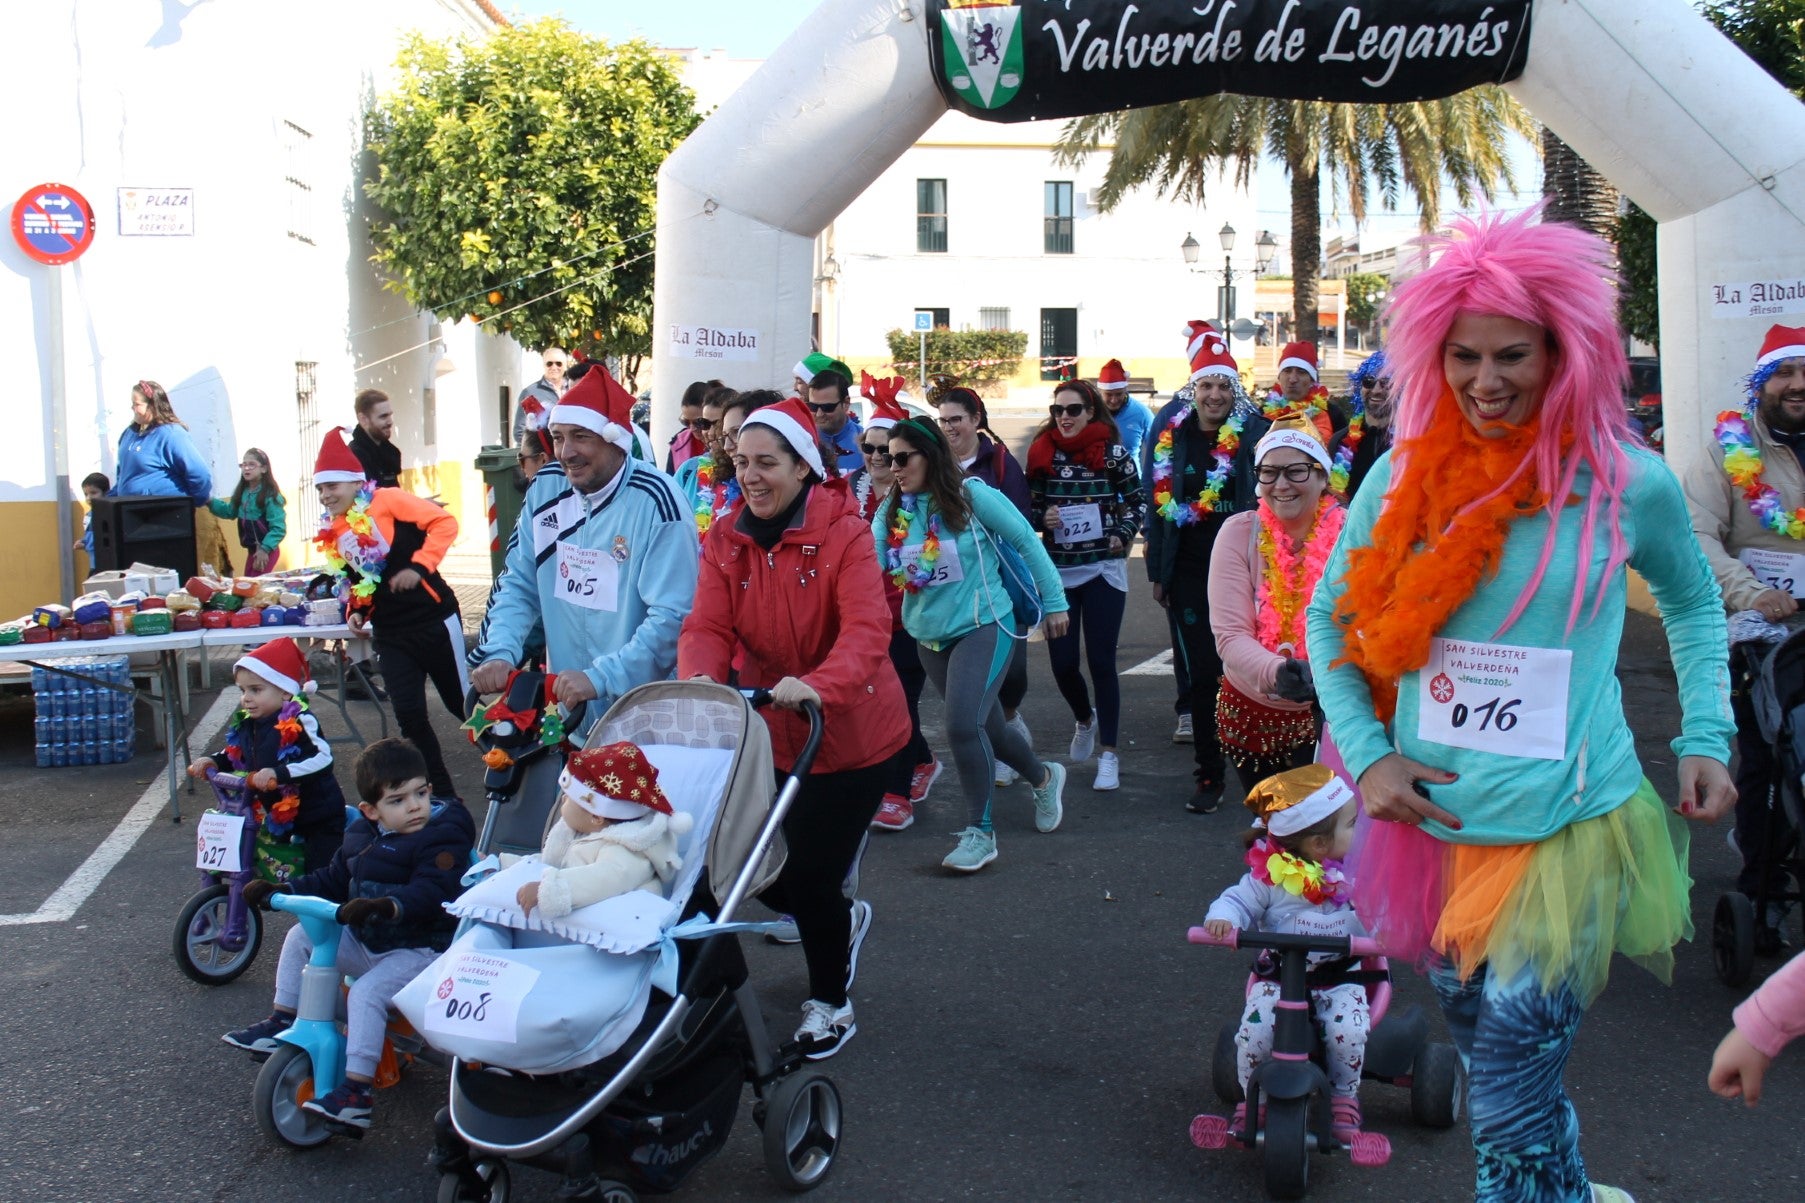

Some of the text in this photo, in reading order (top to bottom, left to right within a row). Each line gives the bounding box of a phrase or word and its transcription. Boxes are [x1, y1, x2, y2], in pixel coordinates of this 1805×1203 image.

[1042, 0, 1508, 87] Valverde de Leganés
[146, 195, 188, 206] PLAZA
[1713, 284, 1741, 304] La
[672, 325, 756, 348] La Aldaba
[541, 521, 559, 530] adidas
[1064, 521, 1091, 537] 022
[567, 578, 598, 596] 005
[1758, 577, 1794, 594] 32
[1446, 644, 1527, 660] SAN SILVESTRE
[1450, 659, 1519, 675] VALVERDEÑA
[1484, 678, 1504, 687] 2020
[1451, 697, 1522, 732] 016
[203, 846, 227, 867] 027
[1297, 918, 1311, 927] SAN
[472, 955, 510, 969] SILVESTRE
[446, 992, 492, 1022] 008
